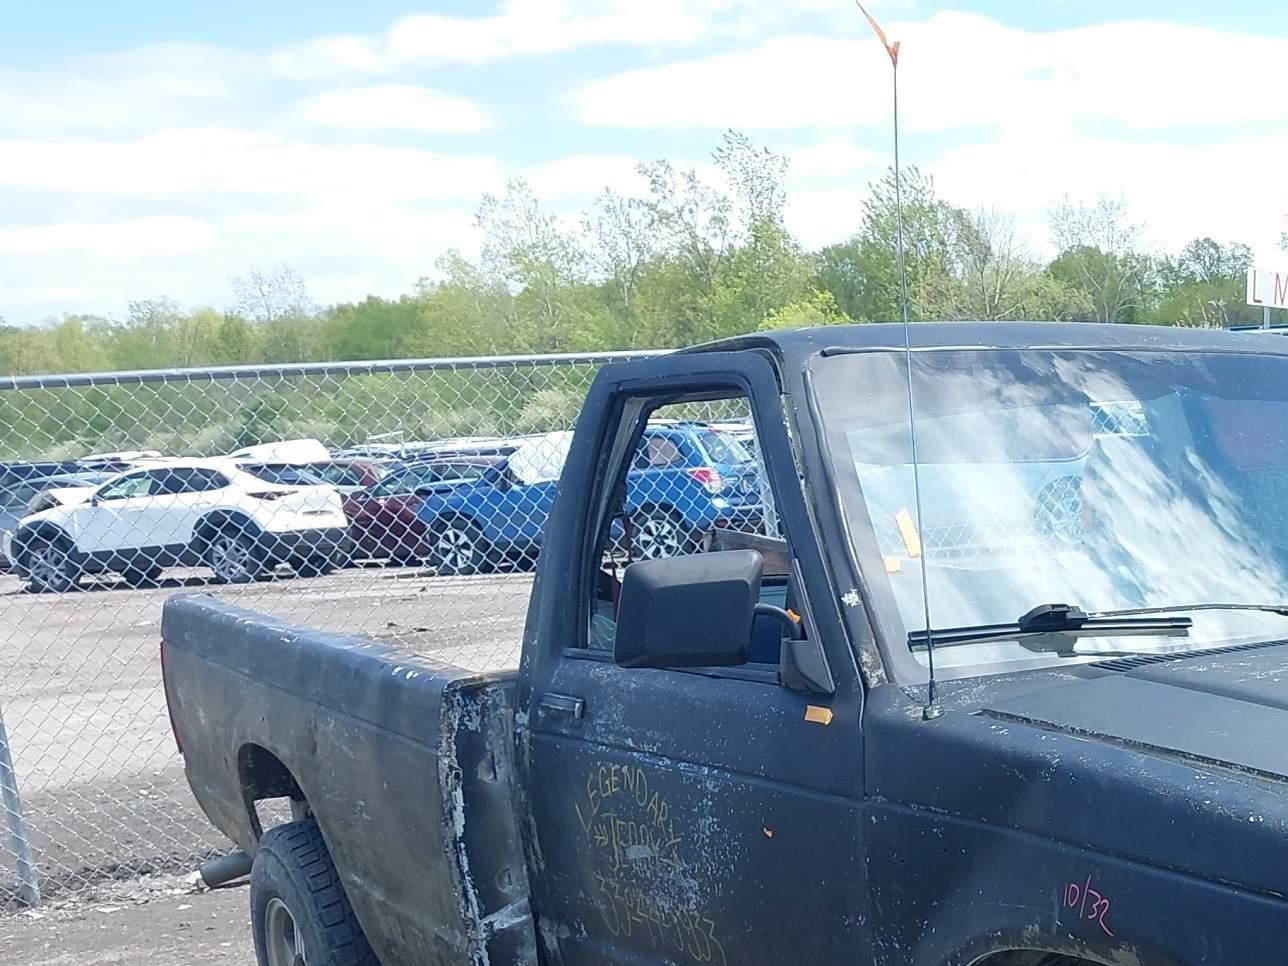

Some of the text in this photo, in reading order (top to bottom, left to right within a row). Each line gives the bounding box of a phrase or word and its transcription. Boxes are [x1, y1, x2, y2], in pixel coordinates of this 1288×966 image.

[1252, 269, 1263, 304] L
[574, 764, 683, 848] LEGENDARY
[1063, 874, 1115, 937] 10/32
